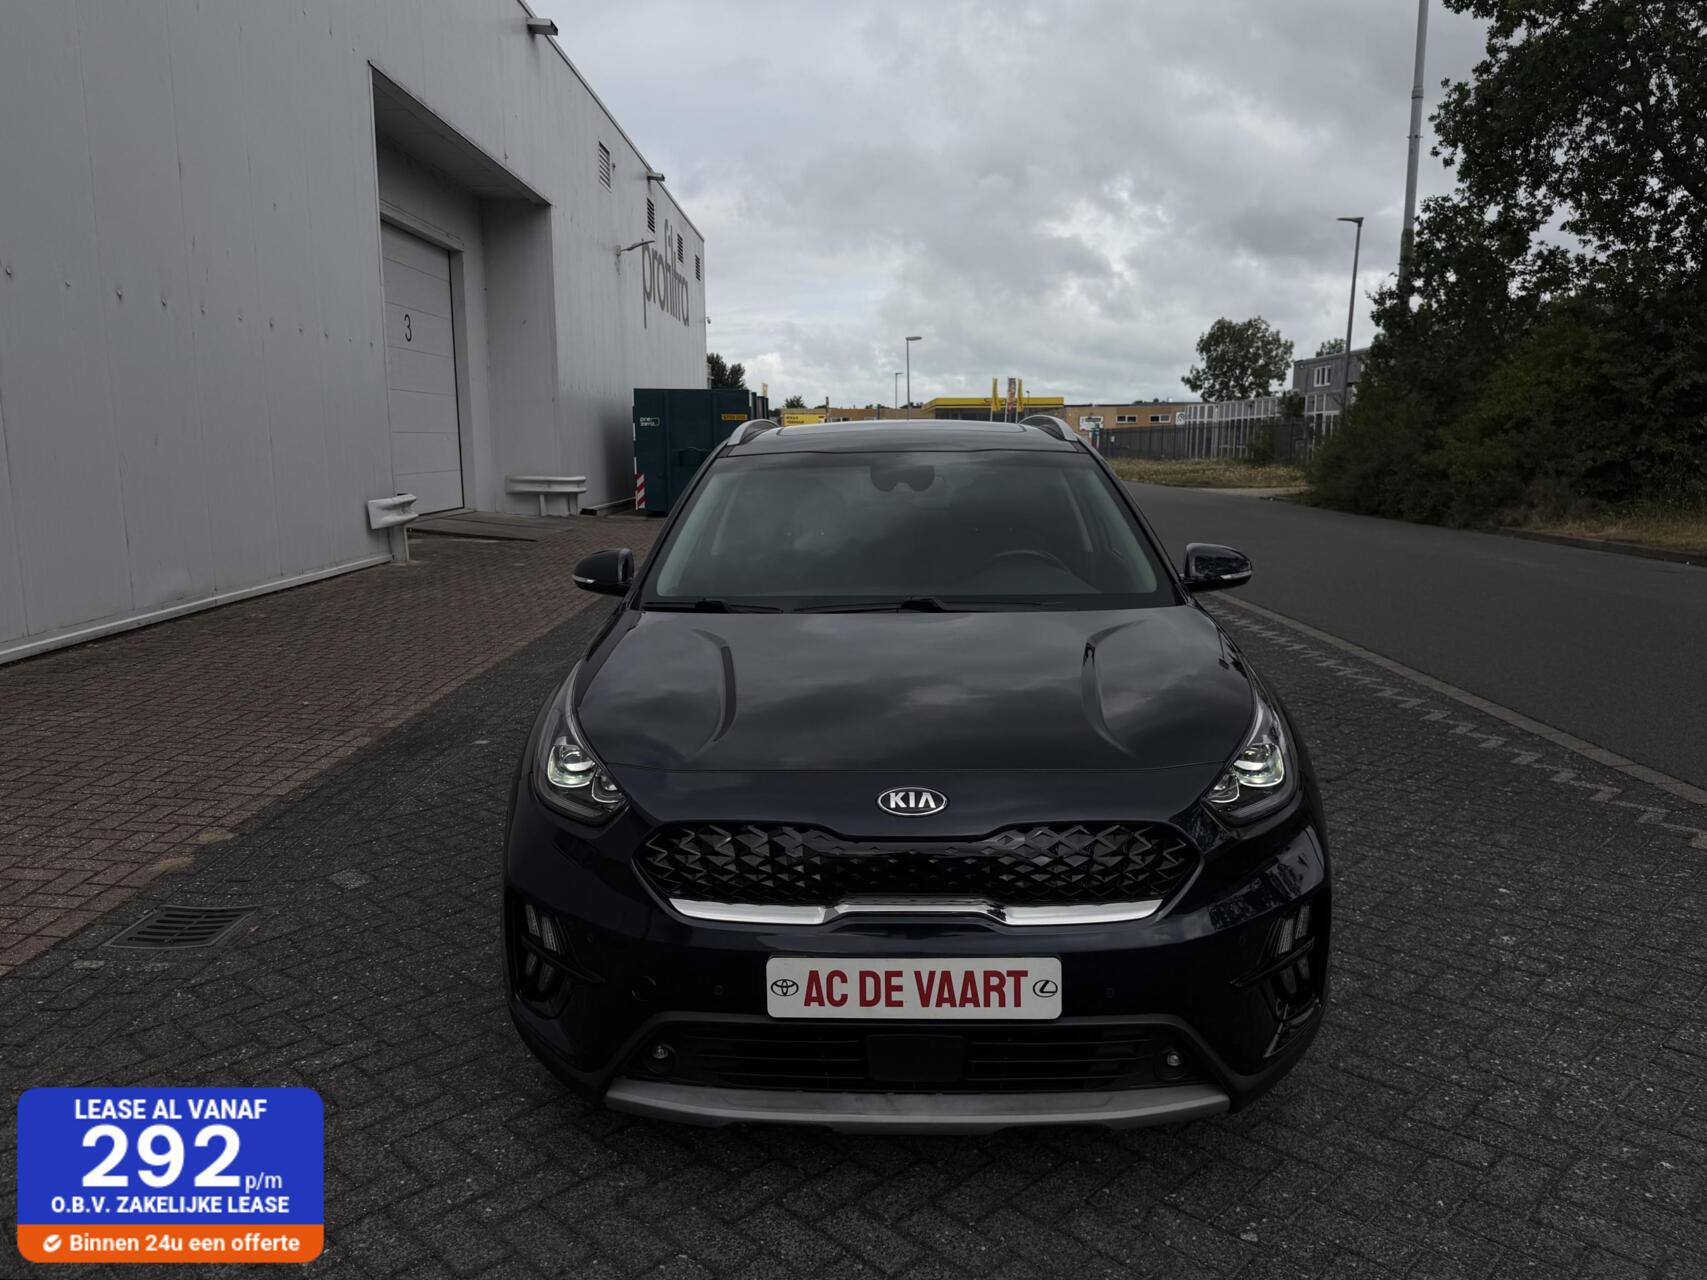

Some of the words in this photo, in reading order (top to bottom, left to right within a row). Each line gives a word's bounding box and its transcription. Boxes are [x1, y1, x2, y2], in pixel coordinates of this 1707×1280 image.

[404, 313, 412, 342] 3
[889, 791, 936, 809] KIA
[803, 969, 849, 1007] AC
[858, 970, 905, 1008] DE
[913, 970, 1029, 1008] VAART
